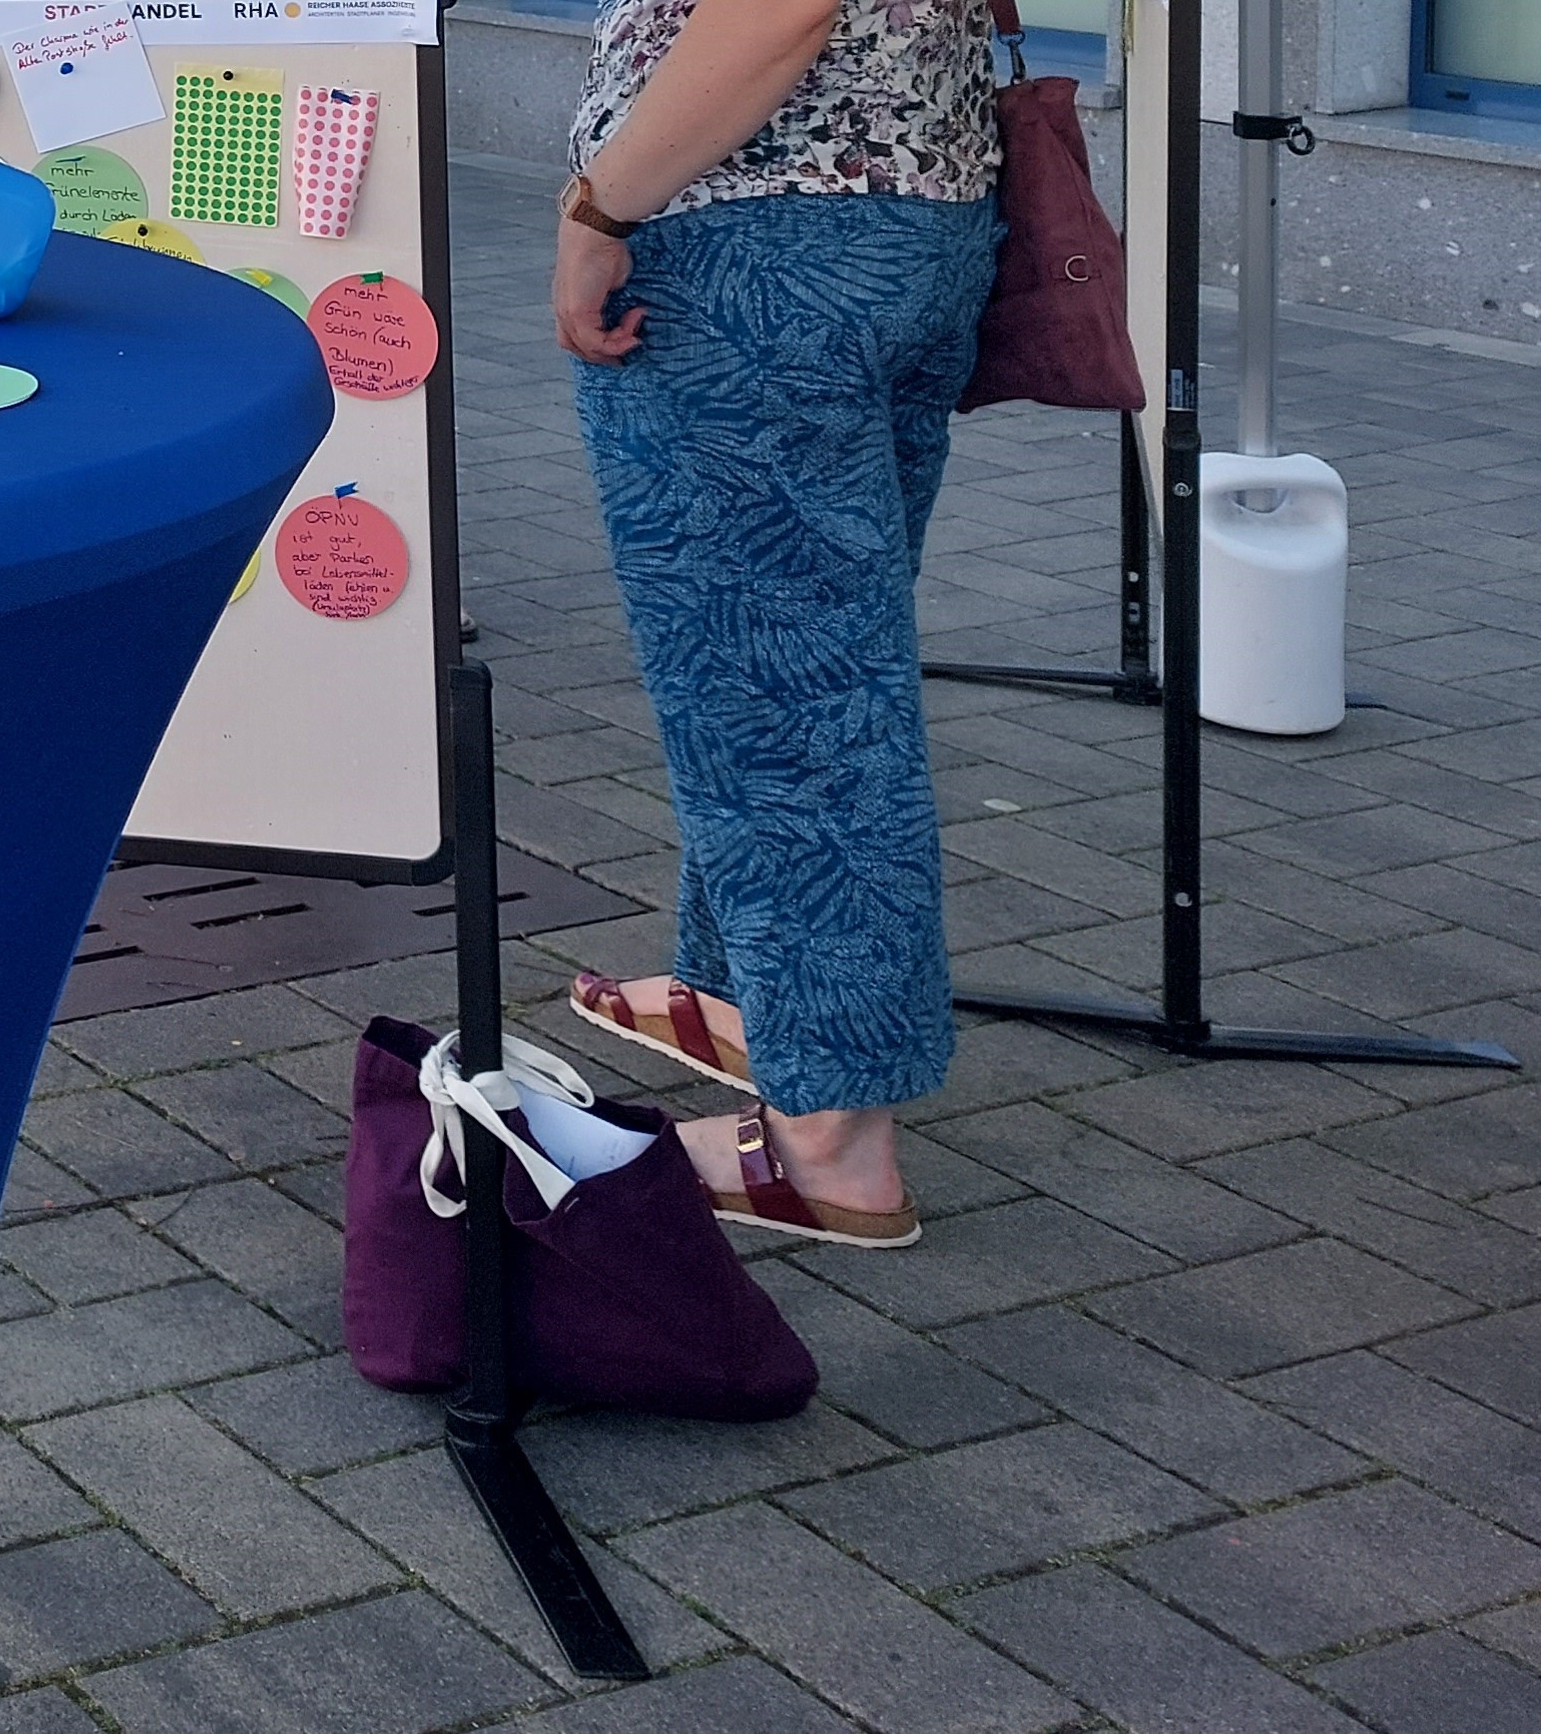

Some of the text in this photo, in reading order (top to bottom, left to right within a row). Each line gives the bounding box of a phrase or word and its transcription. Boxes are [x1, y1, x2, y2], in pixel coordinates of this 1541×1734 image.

[234, 2, 278, 18] RHA
[12, 42, 34, 54] Der
[51, 162, 95, 177] mehr
[59, 209, 98, 221] durch
[344, 287, 388, 301] mehr
[324, 300, 361, 319] Grün
[374, 326, 411, 350] (auch
[329, 347, 393, 376] Blumen)
[305, 506, 359, 526] ÖPNV
[293, 531, 362, 551] ist gut,
[293, 550, 374, 564] aber Parken
